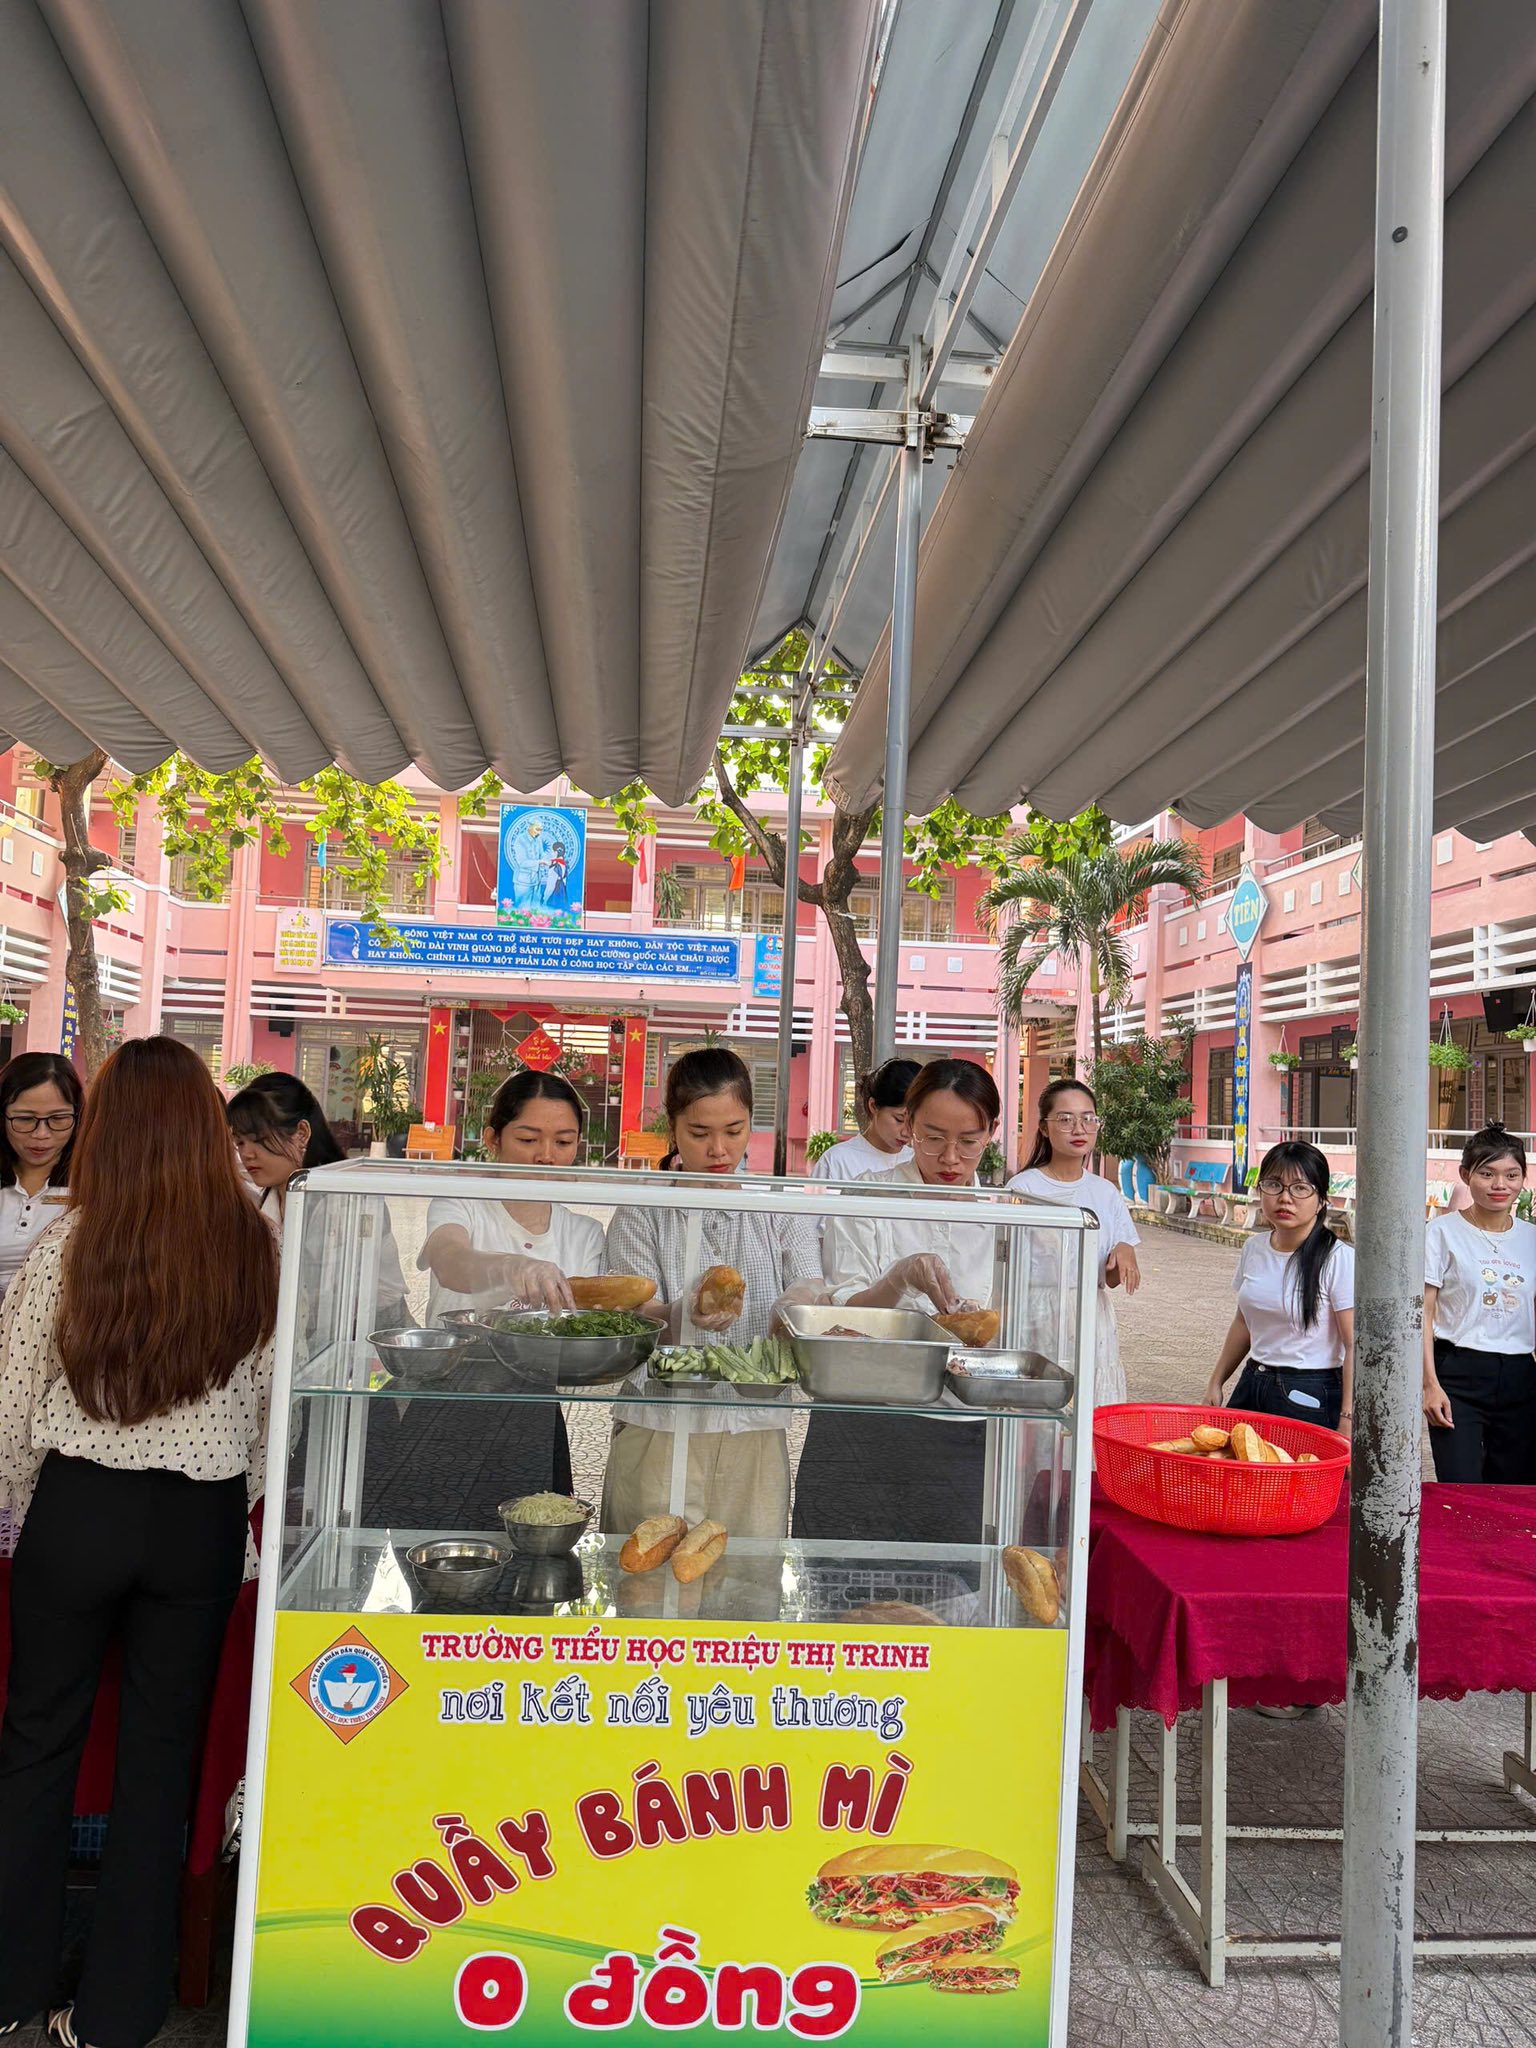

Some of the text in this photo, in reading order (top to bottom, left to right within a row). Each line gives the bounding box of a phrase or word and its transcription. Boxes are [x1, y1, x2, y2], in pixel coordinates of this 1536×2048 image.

[1233, 895, 1259, 928] TIÊN
[368, 939, 380, 948] CÓ
[428, 941, 445, 950] ĐÀI
[447, 943, 469, 951] VINH
[472, 944, 502, 953] QUANG
[504, 942, 518, 954] ĐỂ
[520, 946, 544, 954] SÁNH
[546, 948, 560, 956] VAI
[563, 948, 578, 956] VỚI
[580, 948, 599, 958] CÁC
[600, 950, 630, 958] CƯỜNG
[633, 950, 656, 960] QUỐC
[680, 954, 704, 962] CHÂU
[706, 956, 730, 964] ĐƯỢC
[433, 930, 455, 940] VIỆT
[458, 932, 478, 940] NAM
[482, 932, 494, 941] CÓ
[498, 933, 516, 942] TRỞ
[520, 934, 538, 944] NÊN
[542, 936, 562, 944] TƯƠI
[566, 938, 584, 946] ĐẸP
[586, 938, 606, 947] HAY
[645, 941, 663, 950] DÂN
[666, 942, 684, 951] TỘC
[688, 942, 708, 952] VIỆT
[368, 950, 386, 958] HAY
[426, 952, 455, 962] CHÍNH
[458, 954, 470, 962] LÀ
[472, 954, 491, 963] NHỜ
[493, 955, 514, 965] MỘT
[515, 955, 539, 966] PHẦN
[542, 958, 559, 966] LỚN
[570, 959, 594, 968] CÔNG
[596, 962, 615, 970] HỌC
[617, 962, 634, 971] TẬP
[636, 962, 654, 970] CỦA
[656, 963, 674, 972] CÁC
[316, 1662, 325, 1674] BAN
[324, 1650, 340, 1663] NHÂN
[354, 1648, 370, 1656] QUẬN
[369, 1653, 381, 1666] LIÊN
[422, 1626, 930, 1673] TRƯỜNG TIỂU HỌC TRIỆU THỊ TRINH
[441, 1675, 905, 1739] nơi kết nối yêu thương
[350, 1750, 913, 1963] QUẦY BÁNH MÌ
[565, 1924, 861, 2040] đồng
